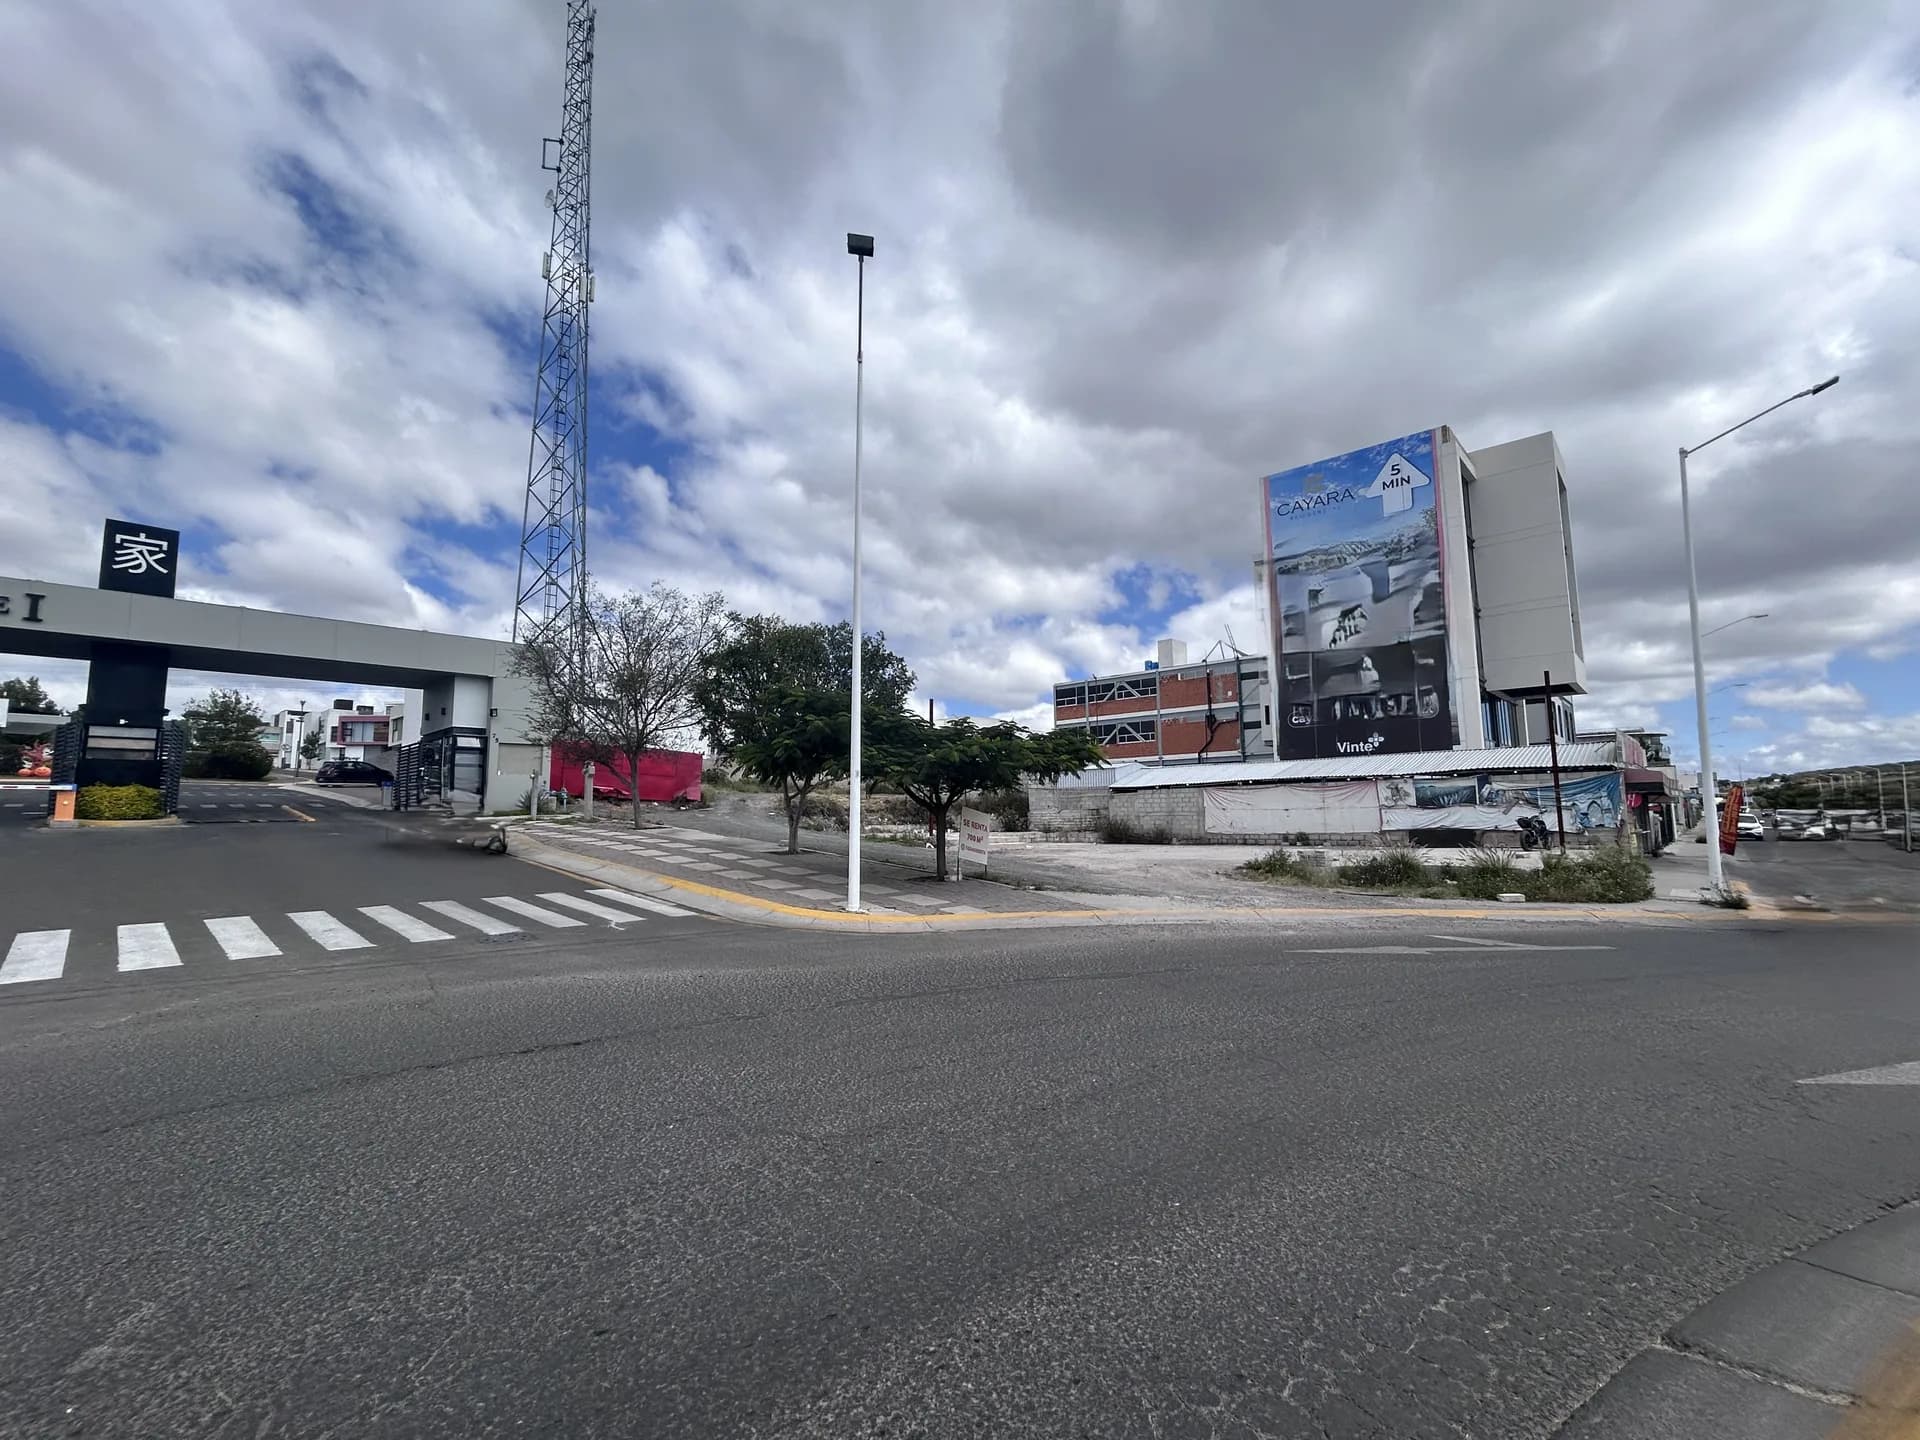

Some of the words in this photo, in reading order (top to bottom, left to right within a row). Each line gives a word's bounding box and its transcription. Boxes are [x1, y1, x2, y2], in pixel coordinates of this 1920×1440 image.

[1390, 463, 1401, 476] 5
[1382, 475, 1411, 490] MIN
[1276, 488, 1355, 517] CAYARA
[111, 532, 169, 574] 家
[1336, 741, 1373, 753] Vinte
[970, 821, 988, 832] RENTA
